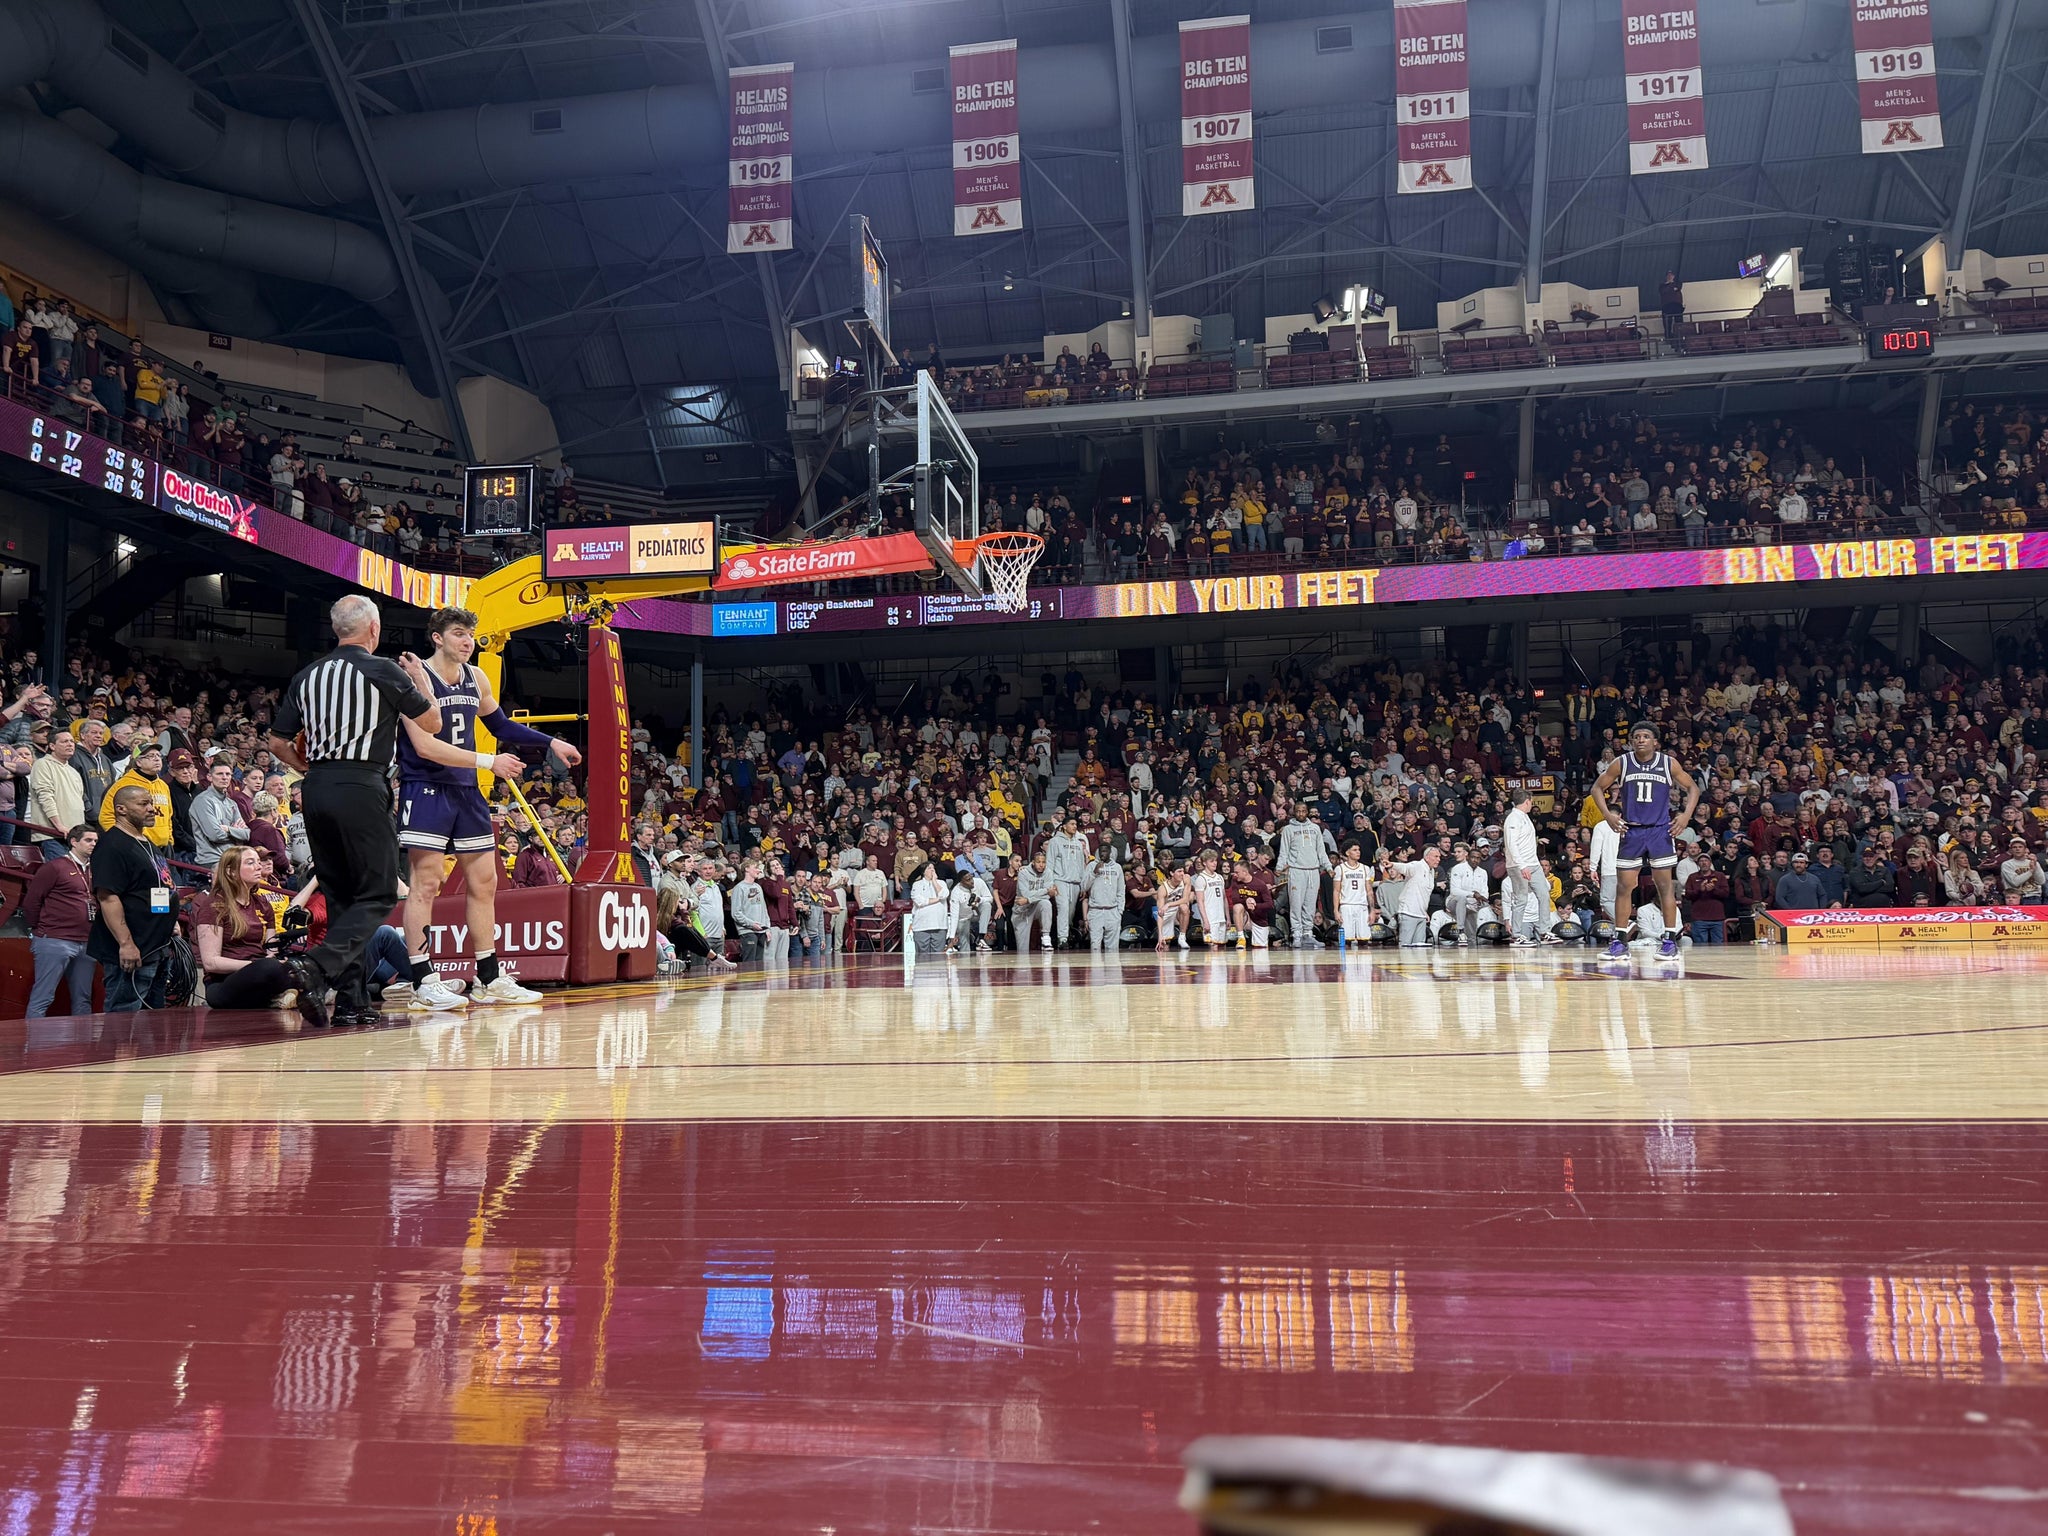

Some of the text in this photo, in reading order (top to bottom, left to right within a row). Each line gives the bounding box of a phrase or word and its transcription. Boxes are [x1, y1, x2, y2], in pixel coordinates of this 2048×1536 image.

[1856, 4, 1928, 21] CHAMPIONS
[1628, 10, 1694, 32] BIG TEN
[1400, 34, 1464, 54] BIG TEN
[1628, 28, 1696, 46] CHAMPIONS
[1185, 56, 1246, 76] BIG TEN
[1400, 52, 1465, 67] CHAMPIONS
[1870, 52, 1922, 74] 1919
[1184, 73, 1248, 90] CHAMPIONS
[1639, 75, 1690, 96] 1917
[736, 87, 787, 105] HELMS
[956, 80, 1014, 100] BIG TEN
[1886, 89, 1912, 98] MEN'S
[735, 102, 787, 115] FOUNDATION
[955, 97, 1015, 114] CHAMPIONS
[1409, 97, 1455, 118] 1911
[1874, 96, 1926, 107] BASKETBALL
[1654, 110, 1680, 120] MEN'S
[738, 121, 784, 135] NATIONAL
[1194, 118, 1240, 138] 1907
[1642, 118, 1692, 130] BASKETBALL
[732, 132, 790, 146] CHAMPIONS
[1422, 132, 1446, 140] MEN'S
[964, 141, 1008, 162] 1906
[1410, 140, 1458, 150] BASKETBALL
[1206, 153, 1230, 162] MEN'S
[739, 161, 781, 180] 1902
[1196, 160, 1240, 170] BASKETBALL
[976, 176, 998, 184] MEN'S
[966, 182, 1010, 194] BASKETBALL
[750, 195, 771, 203] MEN'S
[739, 202, 780, 211] BASKETBALL
[1883, 330, 1930, 350] 10:07
[32, 418, 44, 438] 6
[64, 430, 82, 452] 17
[106, 447, 126, 470] 35
[30, 442, 42, 463] 8
[60, 454, 82, 478] 22
[104, 470, 124, 494] 36
[164, 470, 234, 520] Old Dutch
[175, 504, 198, 522] Quality
[198, 512, 214, 526] Lives
[580, 541, 624, 553] HEALTH
[638, 538, 705, 558] PEDIATRICS
[581, 553, 611, 561] FAIRVIEW
[1724, 533, 2024, 584] ON YOUR FEET
[360, 548, 393, 597] ON
[1118, 568, 1380, 617] ON YOUR FEET
[790, 599, 874, 612] College Basketball
[927, 596, 962, 605] College
[927, 604, 982, 614] Sacramento
[1030, 600, 1041, 610] 13
[1049, 603, 1054, 611] 1
[719, 609, 768, 620] TENNANT
[790, 607, 898, 621] UCLA 84
[906, 610, 912, 618] 2
[927, 610, 1041, 622] Idaho 27
[720, 622, 768, 630] COMPANY
[790, 616, 898, 630] USC 63
[452, 713, 465, 745] 2
[608, 638, 628, 842] MINNESOTA
[1507, 780, 1520, 788] 105
[1527, 779, 1541, 787] 106
[1636, 782, 1652, 802] 11
[1352, 880, 1358, 890] 9
[1215, 888, 1220, 897] 8
[599, 891, 650, 951] Cub
[434, 962, 470, 972] REDIT
